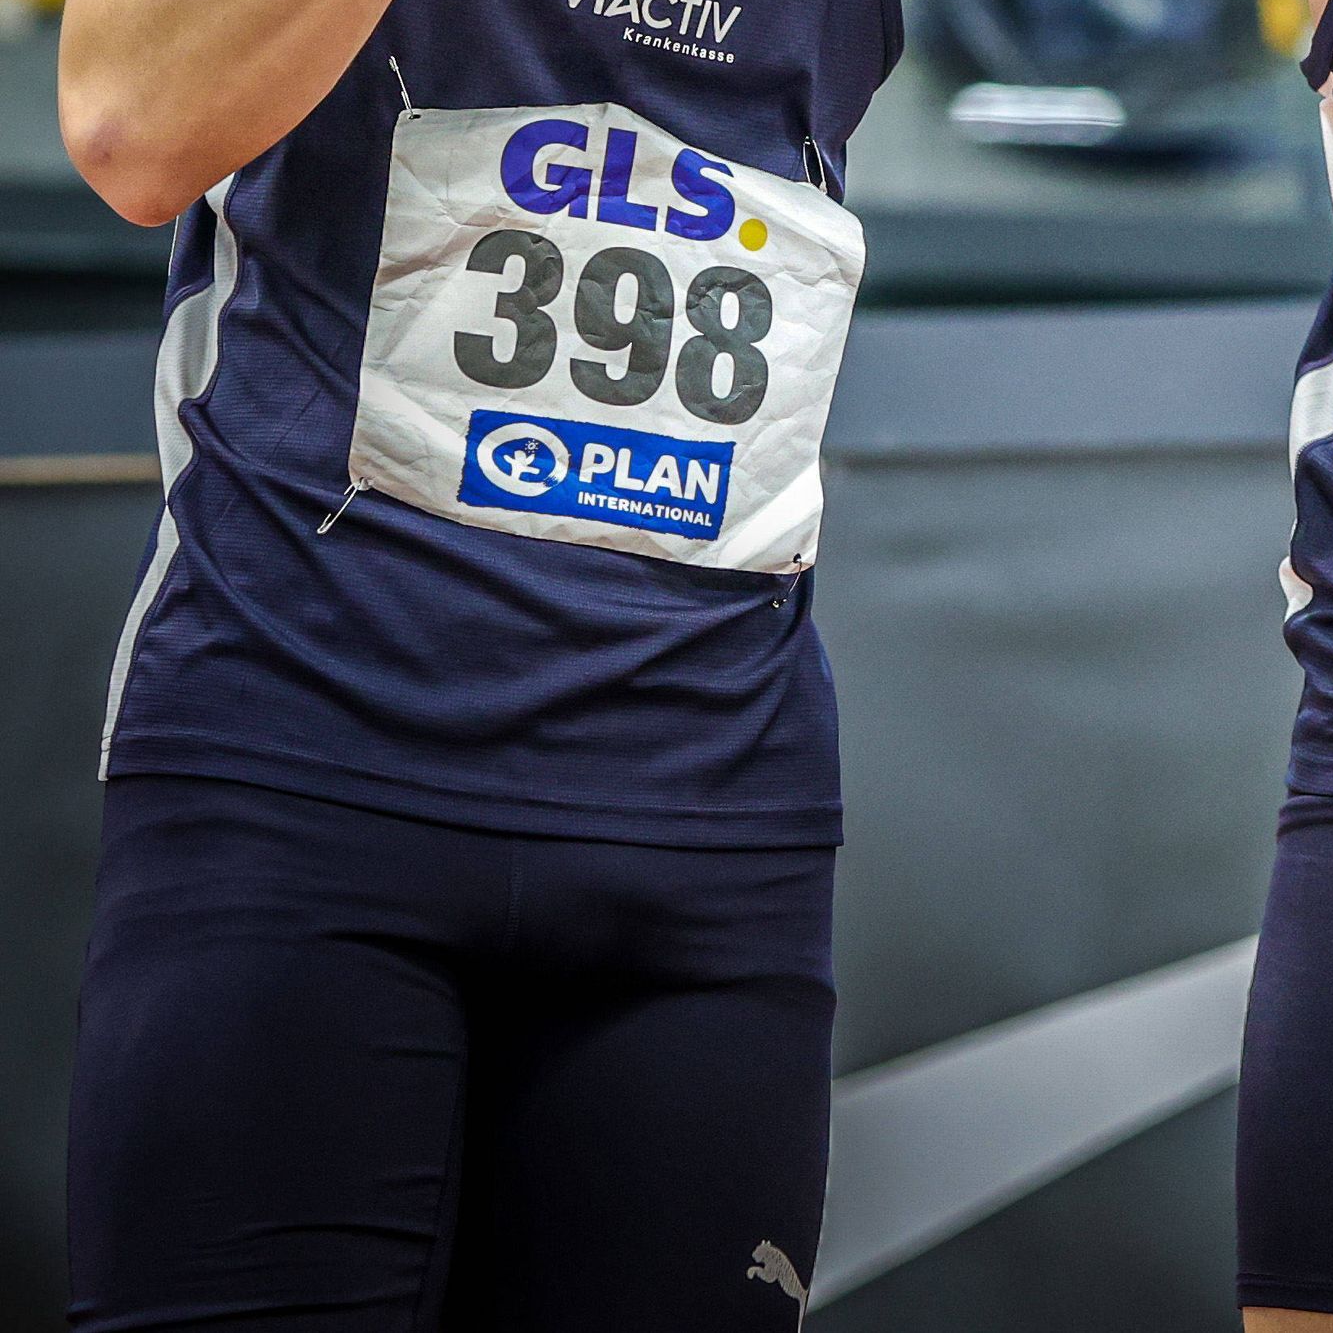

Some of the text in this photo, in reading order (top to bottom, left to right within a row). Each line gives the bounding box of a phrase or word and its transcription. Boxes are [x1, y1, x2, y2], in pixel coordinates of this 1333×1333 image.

[623, 26, 736, 64] Krankenkasse
[453, 229, 773, 425] 398
[578, 442, 720, 503] PLAN
[578, 491, 713, 527] INTERNATIONAL
